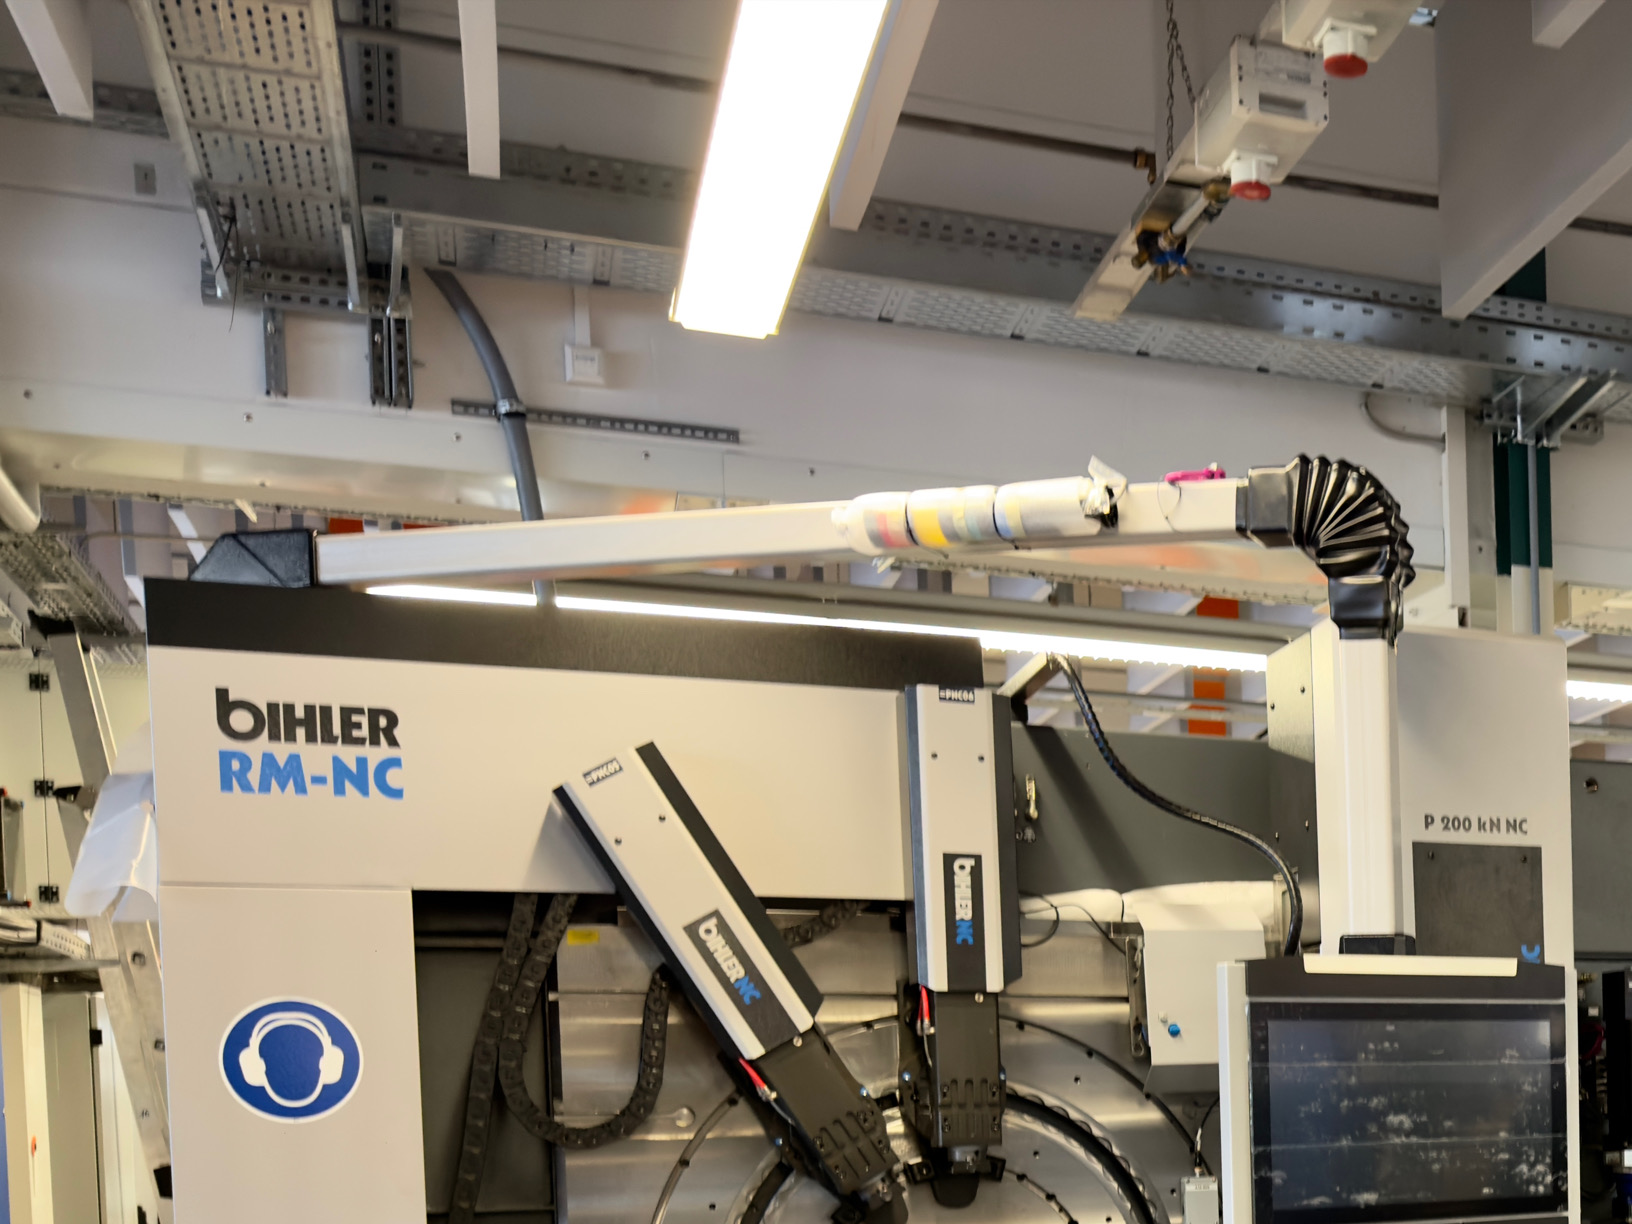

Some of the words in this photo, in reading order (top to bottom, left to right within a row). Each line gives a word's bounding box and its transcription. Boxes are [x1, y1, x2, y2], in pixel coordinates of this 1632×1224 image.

[218, 750, 405, 800] RM-NC
[1423, 815, 1436, 832] P
[1442, 815, 1473, 833] 200
[1477, 816, 1502, 834] kN
[1505, 817, 1529, 835] NC
